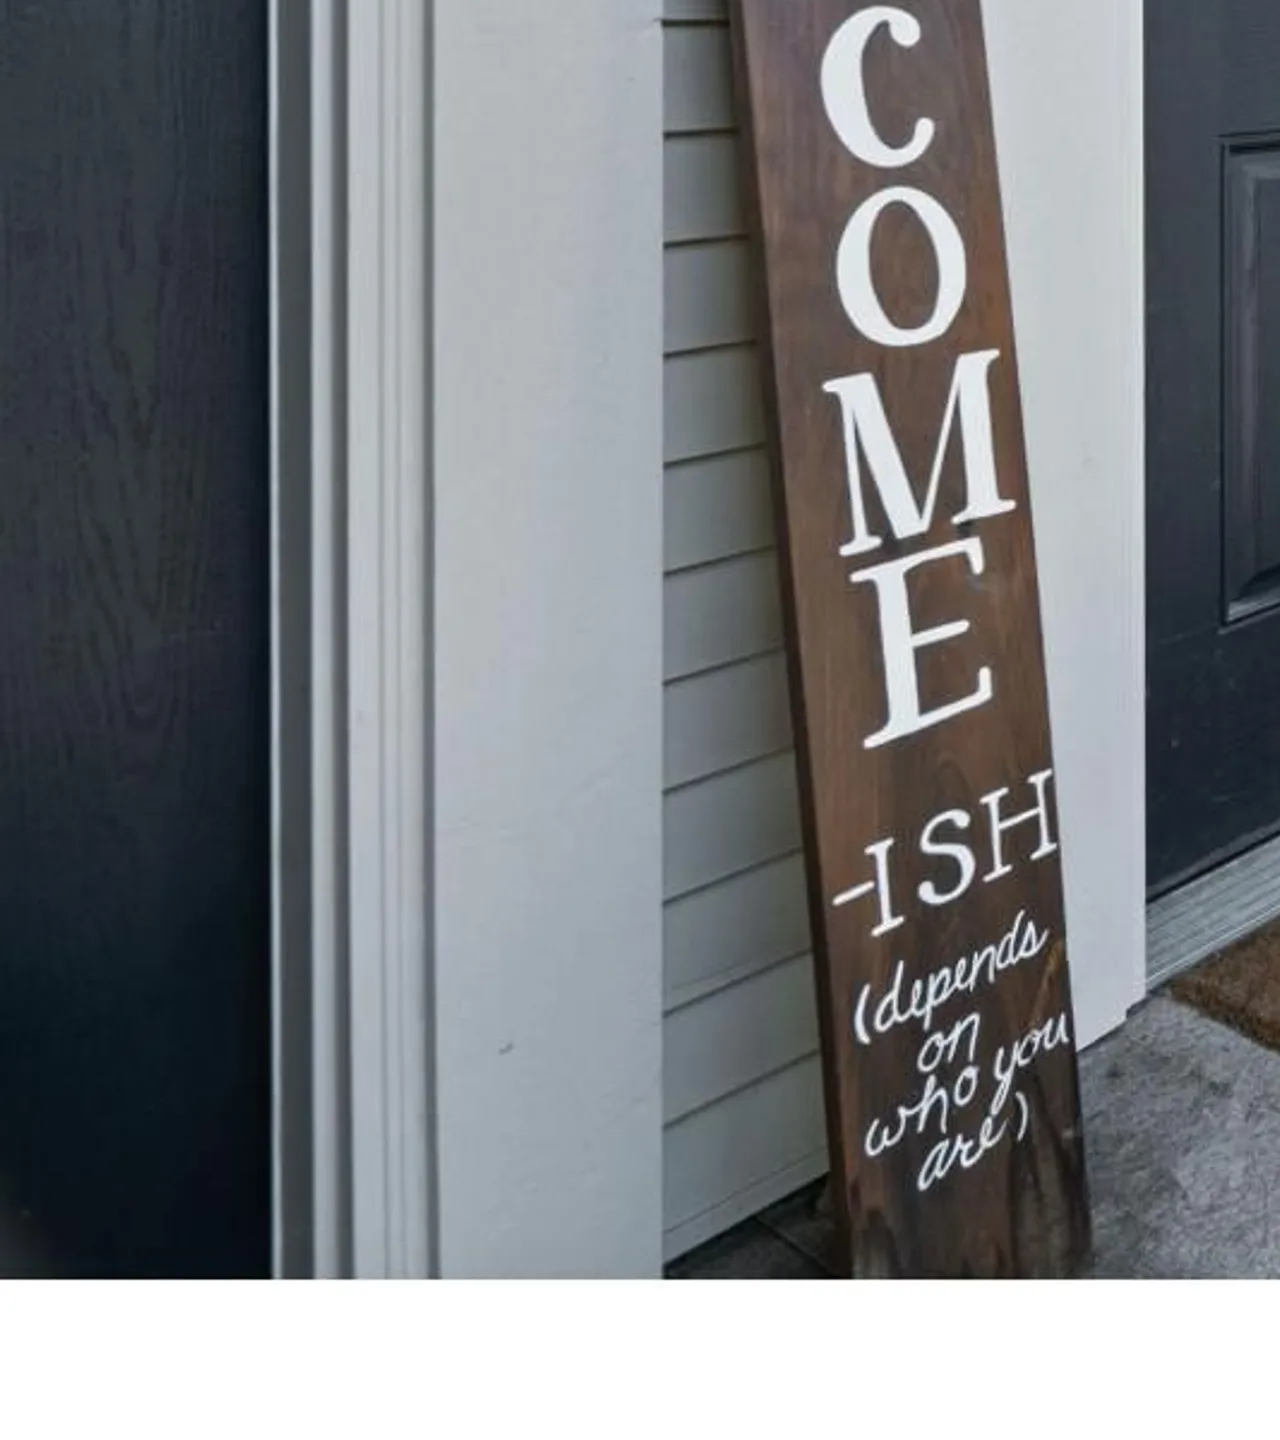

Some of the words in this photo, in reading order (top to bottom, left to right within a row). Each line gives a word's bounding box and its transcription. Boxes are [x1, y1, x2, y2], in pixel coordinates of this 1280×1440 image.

[832, 768, 1058, 937] -ISH
[853, 909, 1049, 1045] (depends
[918, 1012, 981, 1073] on
[864, 1066, 979, 1157] who
[993, 1013, 1070, 1116] you
[917, 1092, 1029, 1193] are)
